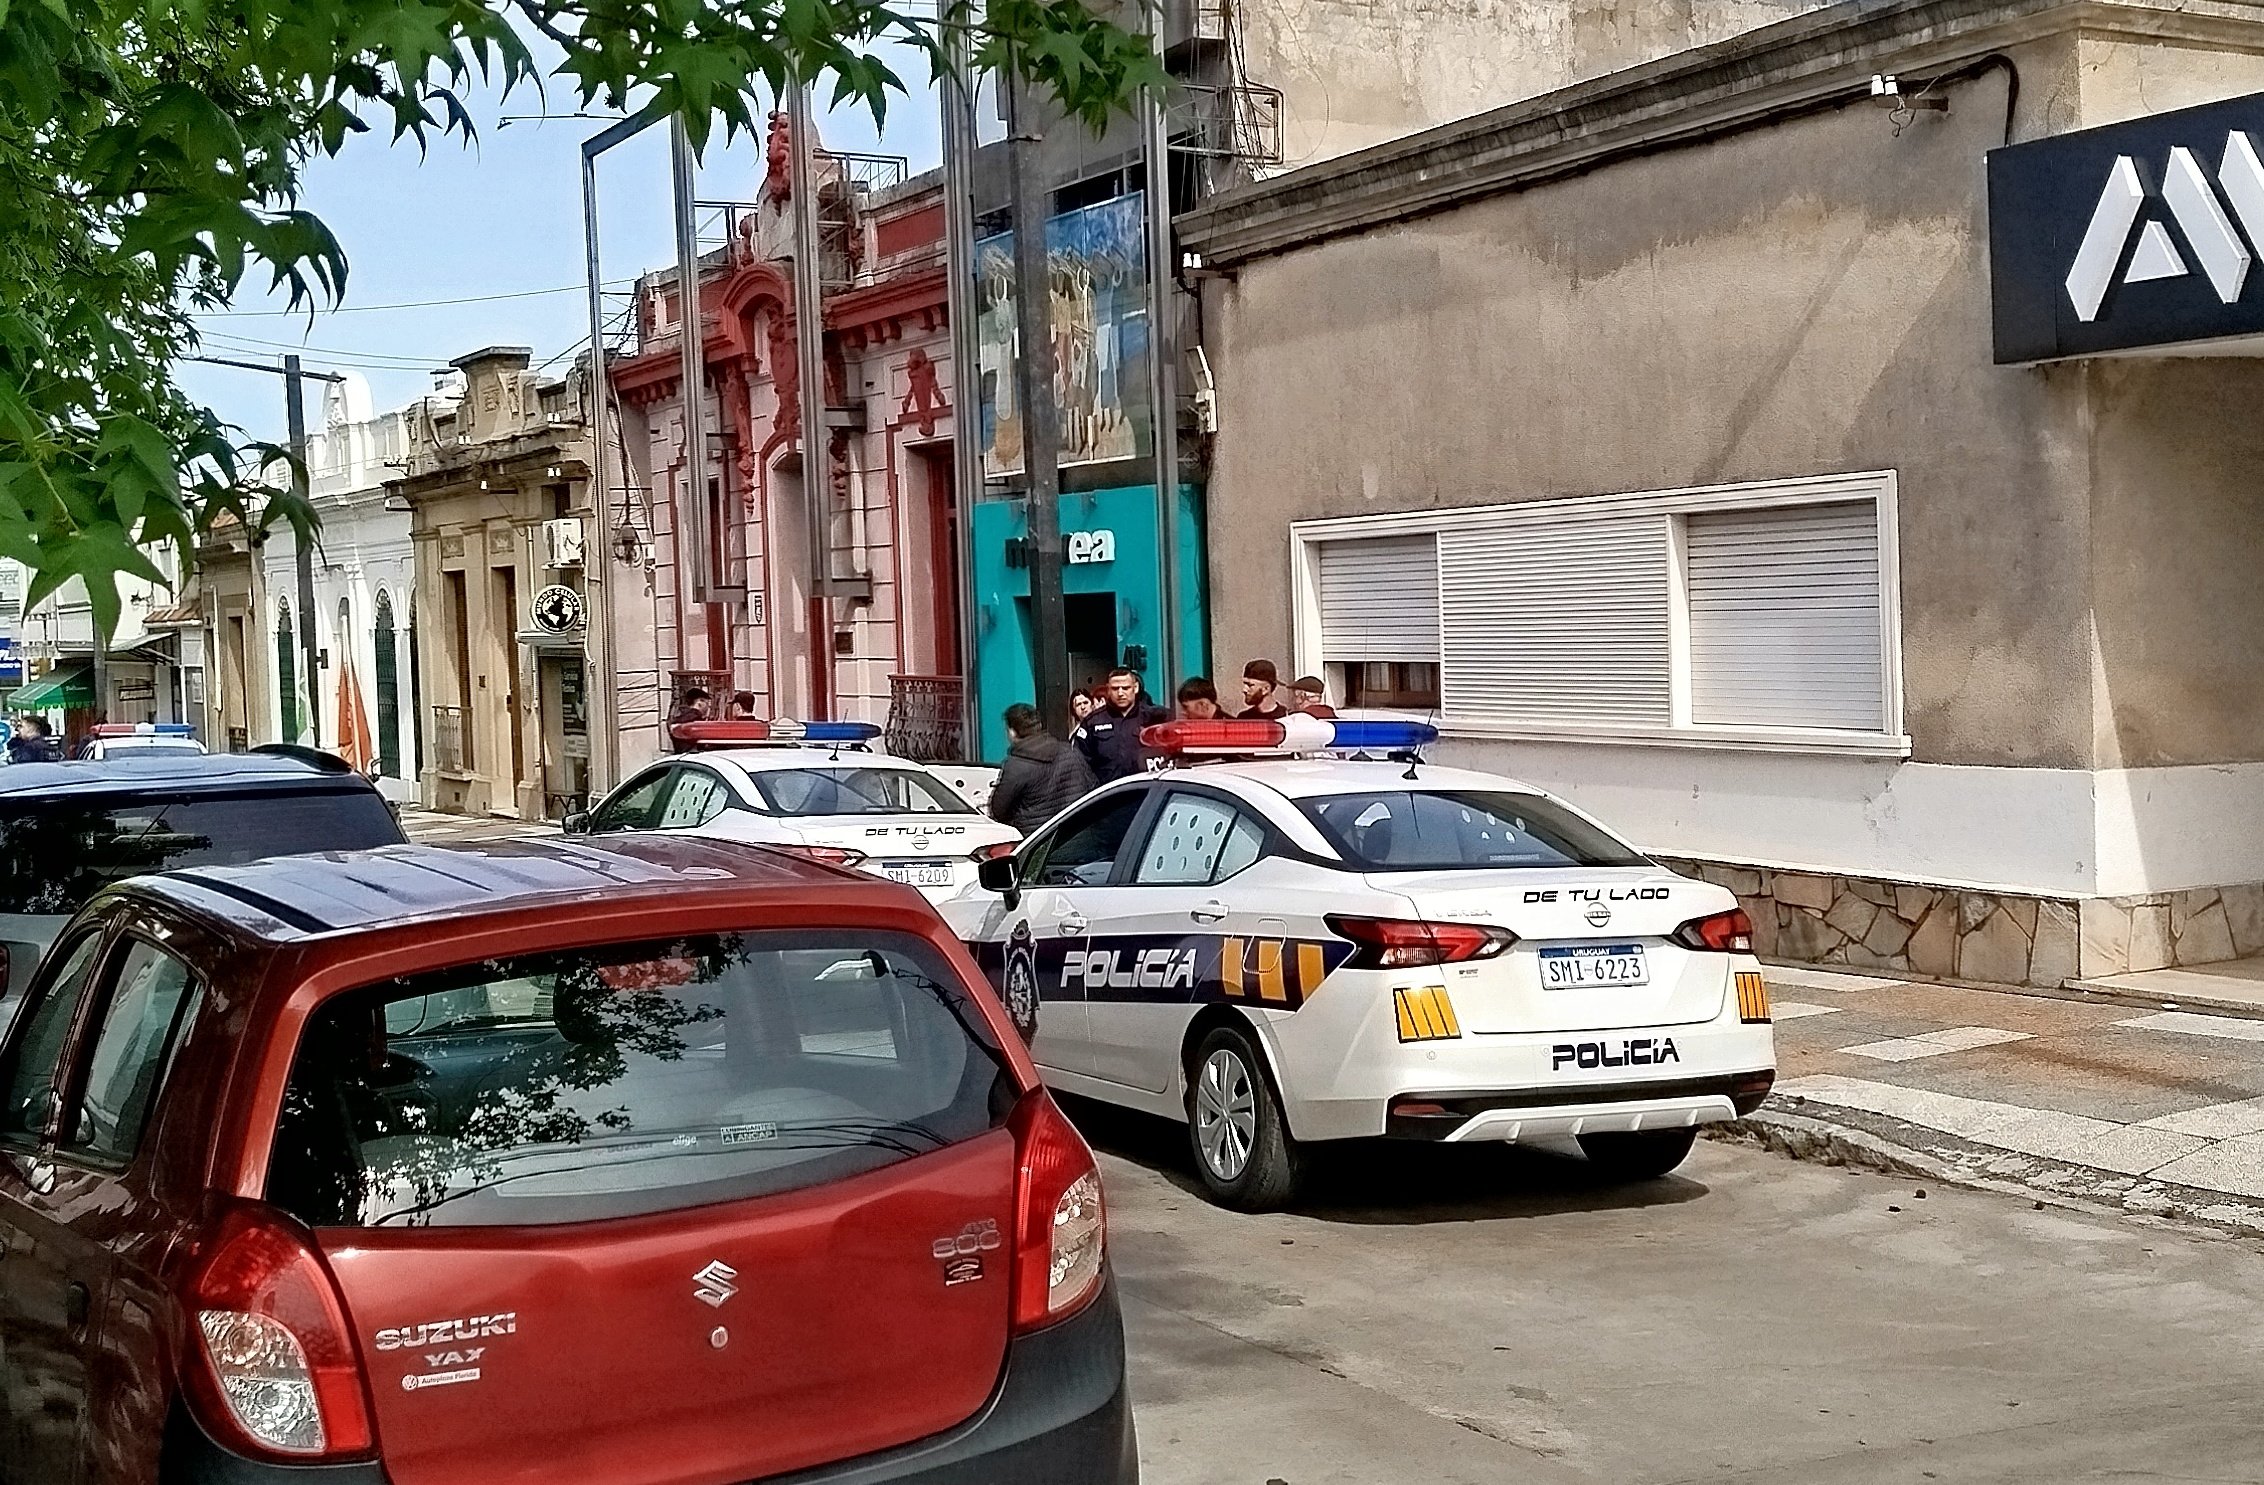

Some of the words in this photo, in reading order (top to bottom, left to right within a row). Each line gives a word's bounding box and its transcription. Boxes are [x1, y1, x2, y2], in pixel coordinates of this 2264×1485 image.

[865, 828, 889, 836] DE
[895, 827, 918, 835] TU
[923, 826, 966, 835] LADO
[1523, 890, 1558, 904] DE
[1569, 889, 1602, 902] TU
[1609, 887, 1670, 901] LADO
[1572, 948, 1611, 957] URUGUAY
[375, 1312, 517, 1351] SUZUKI
[425, 1347, 486, 1367] YAX
